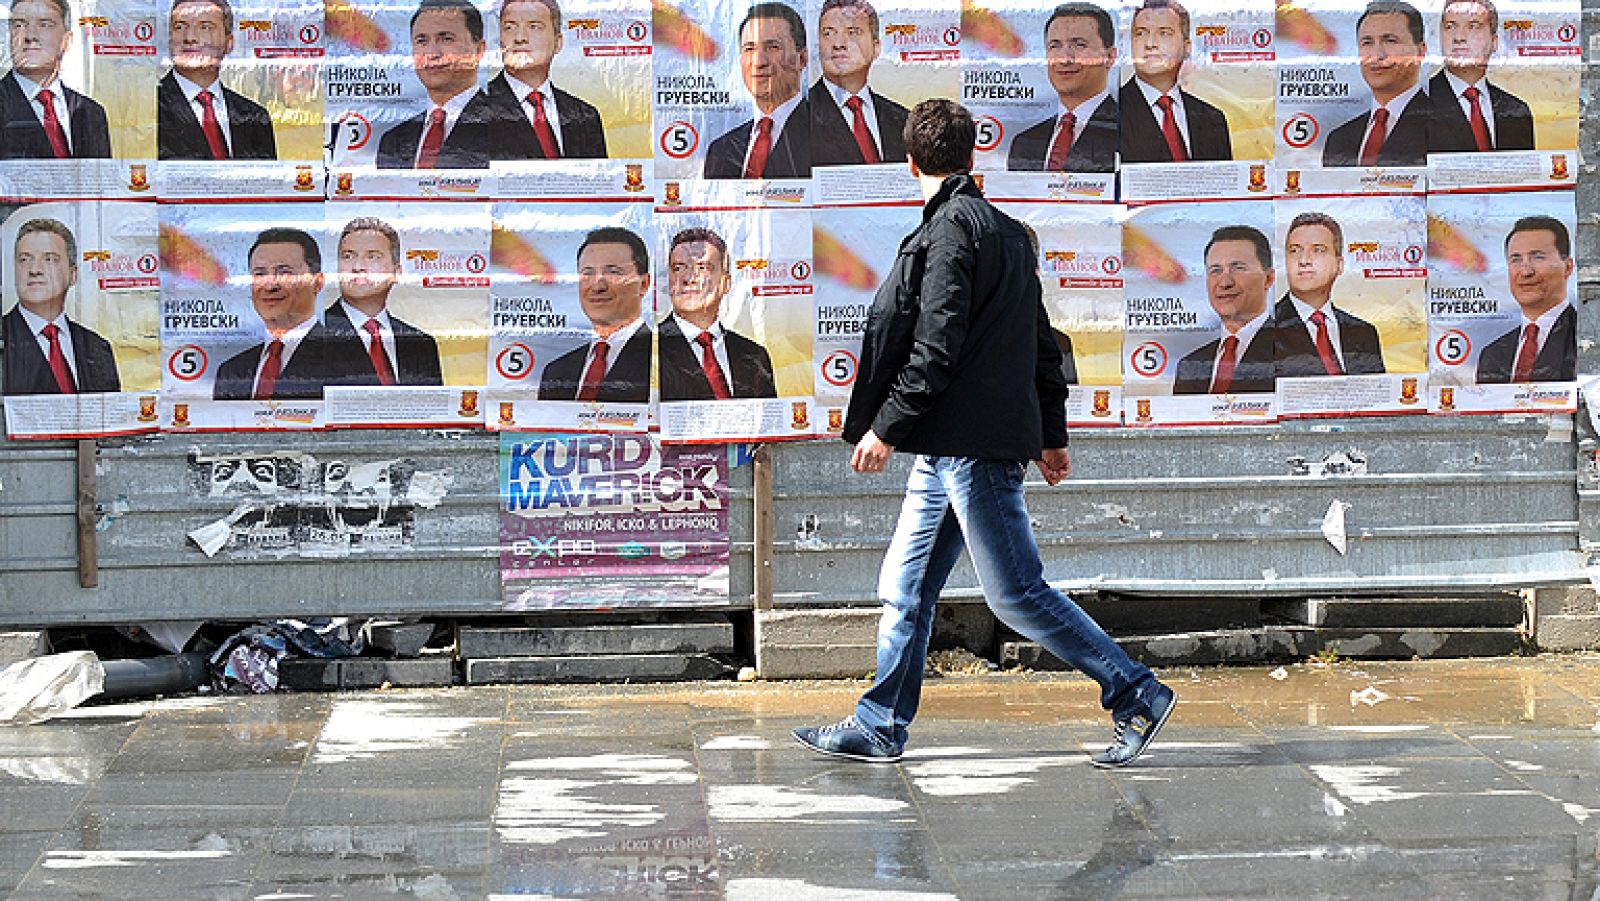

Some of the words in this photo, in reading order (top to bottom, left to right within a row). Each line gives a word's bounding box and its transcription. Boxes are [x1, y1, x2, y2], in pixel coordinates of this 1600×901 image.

[328, 68, 387, 81] НИКОЛА
[964, 71, 1021, 84] НИКОЛА
[1280, 69, 1336, 81] НИКОЛА
[657, 76, 716, 88] НИКОЛА
[328, 83, 401, 96] ГРУЕВСКИ
[964, 86, 1034, 99] ГРУЕВСКИ
[1280, 84, 1348, 97] ГРУЕВСКИ
[657, 92, 730, 105] ГРУЕВСКИ
[978, 124, 992, 144] 5
[1293, 121, 1308, 141] 5
[672, 129, 688, 151] 5
[1431, 287, 1486, 299] НИКОЛА
[164, 300, 225, 313] НИКОЛА
[494, 298, 552, 313] НИКОЛА
[1127, 298, 1183, 311] НИКОЛА
[1430, 301, 1497, 313] ГРУЕВСКИ
[165, 315, 238, 328] ГРУЕВСКИ
[494, 314, 566, 328] ГРУЕВСКИ
[1128, 311, 1196, 326] ГРУЕВСКИ
[818, 321, 868, 334] ГРУЕВС
[1447, 337, 1461, 359] 5
[181, 352, 196, 374] 5
[508, 352, 523, 372] 5
[1144, 349, 1156, 370] 5
[835, 358, 848, 378] 5
[510, 435, 652, 481] KURD
[508, 465, 720, 511] MAVERICK
